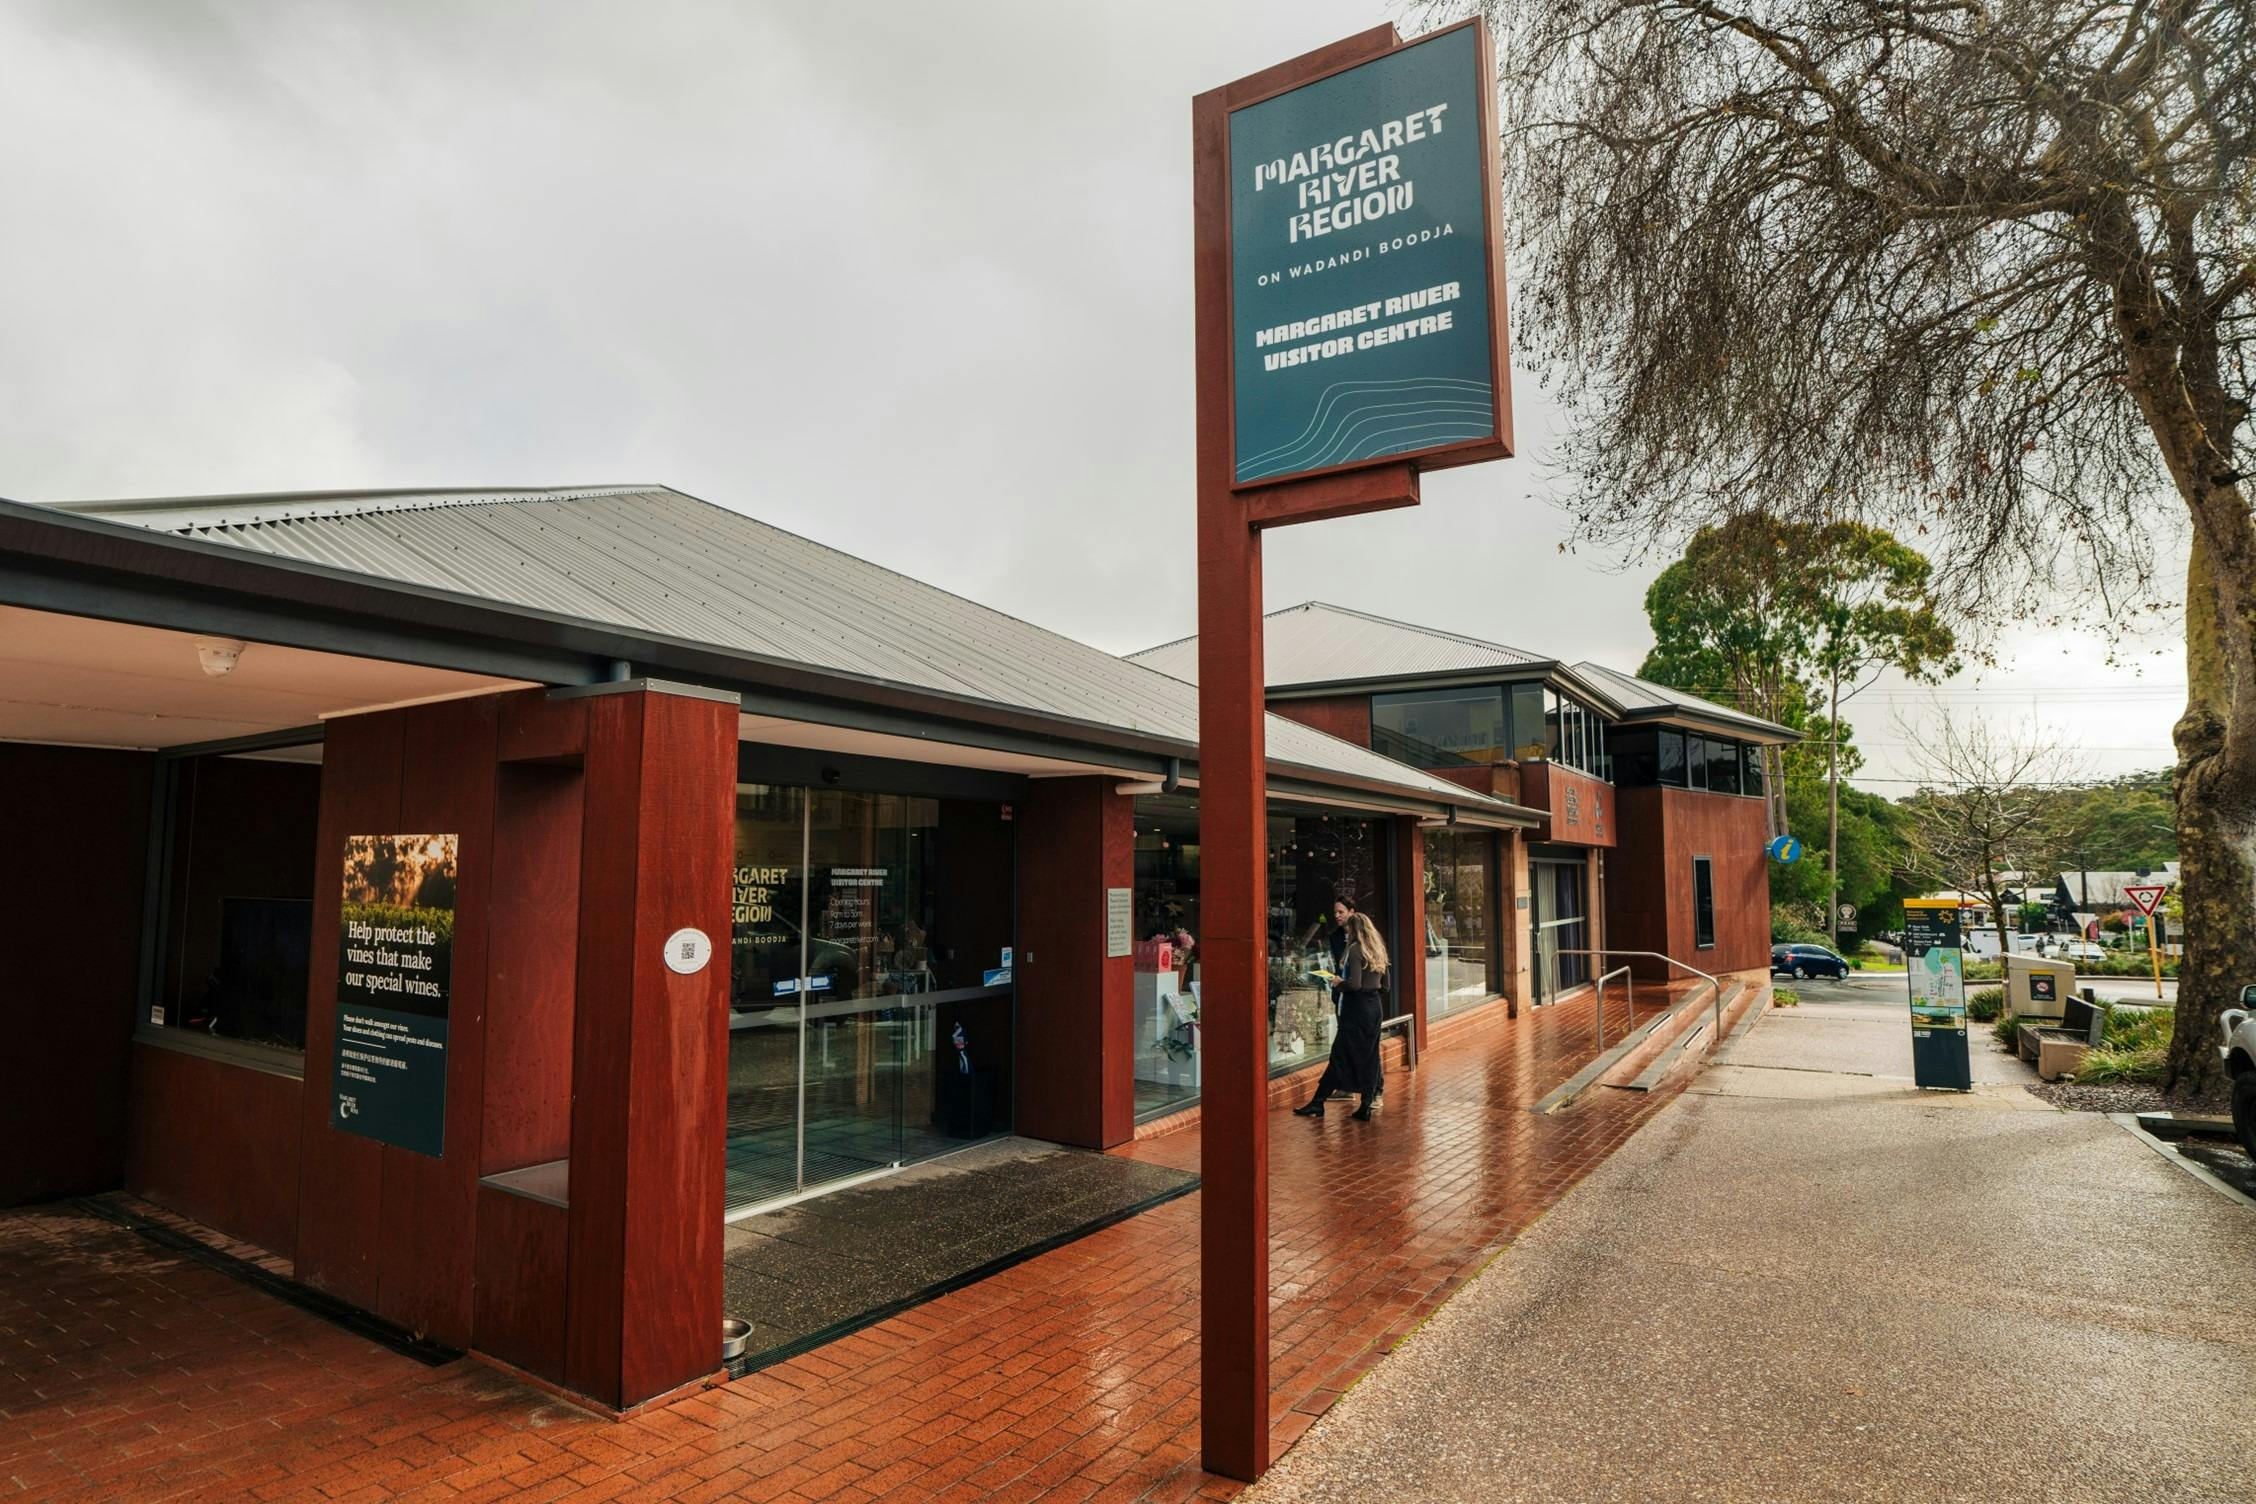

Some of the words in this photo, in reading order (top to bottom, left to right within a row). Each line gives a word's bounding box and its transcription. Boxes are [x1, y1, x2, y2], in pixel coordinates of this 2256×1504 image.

[1255, 103, 1448, 192] MARGARET
[1299, 154, 1401, 209] RIVER
[1290, 181, 1413, 244] REGION
[1258, 271, 1280, 287] ON
[1289, 247, 1370, 278] WADANDI
[1379, 223, 1454, 254] BOODJA
[1256, 301, 1382, 348] MARGARET
[1385, 281, 1460, 316] RIVER
[1264, 336, 1354, 371] VISITOR
[1357, 311, 1453, 350] CENTRE
[732, 867, 788, 884] RGARET
[831, 878, 857, 887] VISITOR
[858, 878, 884, 887] CENTRE
[732, 886, 768, 904] IVER
[732, 905, 772, 923] GION
[348, 921, 372, 945] Help
[374, 926, 414, 946] protect
[416, 925, 436, 946] the
[732, 937, 752, 945] ANDI
[347, 944, 374, 964] vines
[376, 947, 398, 967] that
[401, 950, 432, 971] make
[345, 971, 364, 987] our
[366, 971, 402, 994] special
[405, 975, 441, 998] wines.
